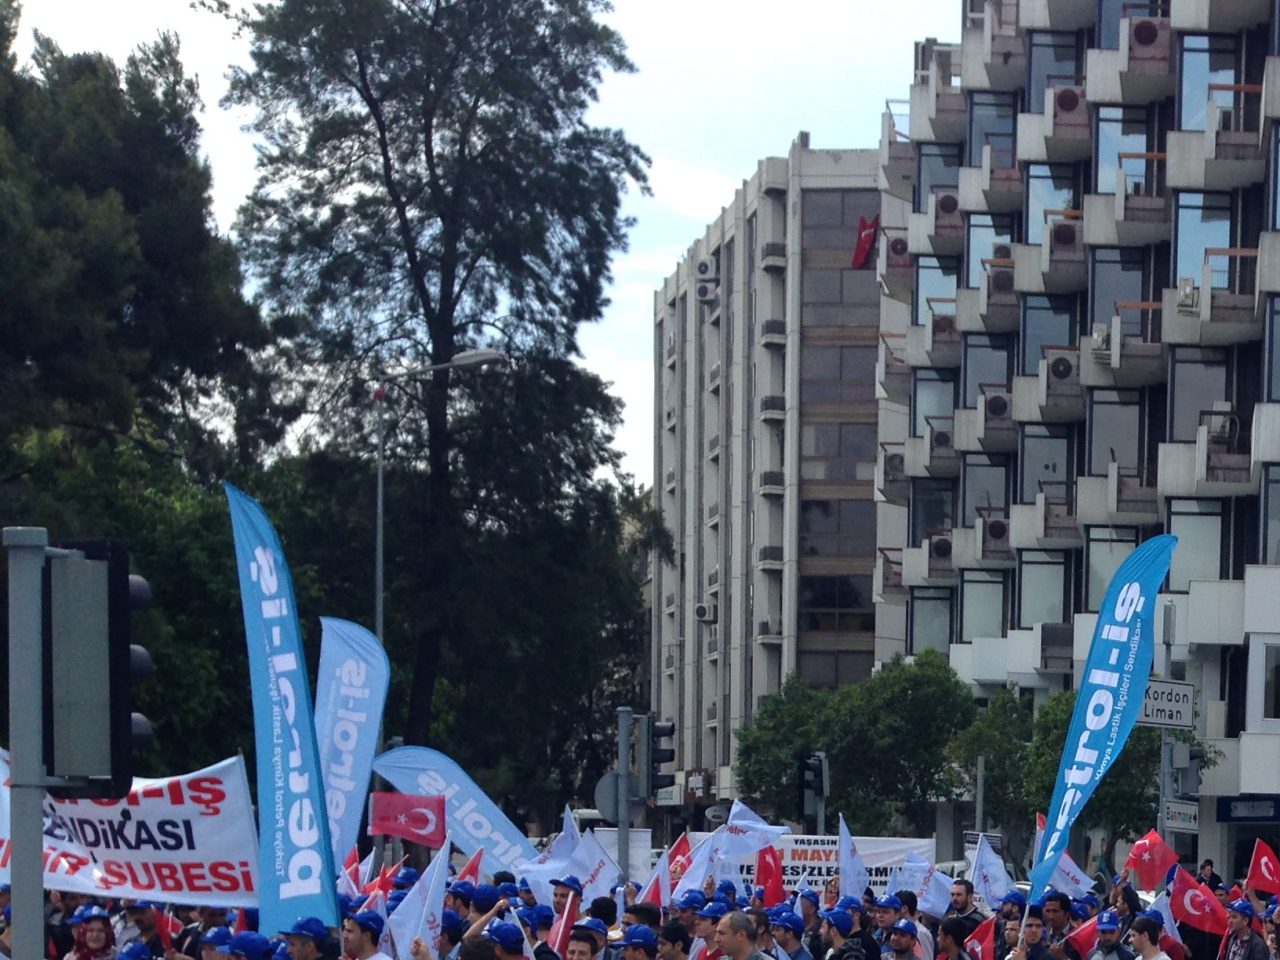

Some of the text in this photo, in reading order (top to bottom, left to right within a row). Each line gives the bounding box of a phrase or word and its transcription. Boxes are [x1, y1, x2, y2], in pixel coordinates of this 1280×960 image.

[1145, 686, 1189, 704] Kordon
[1144, 704, 1183, 721] Liman
[1109, 712, 1121, 747] Lastik
[791, 848, 839, 862] MAYI
